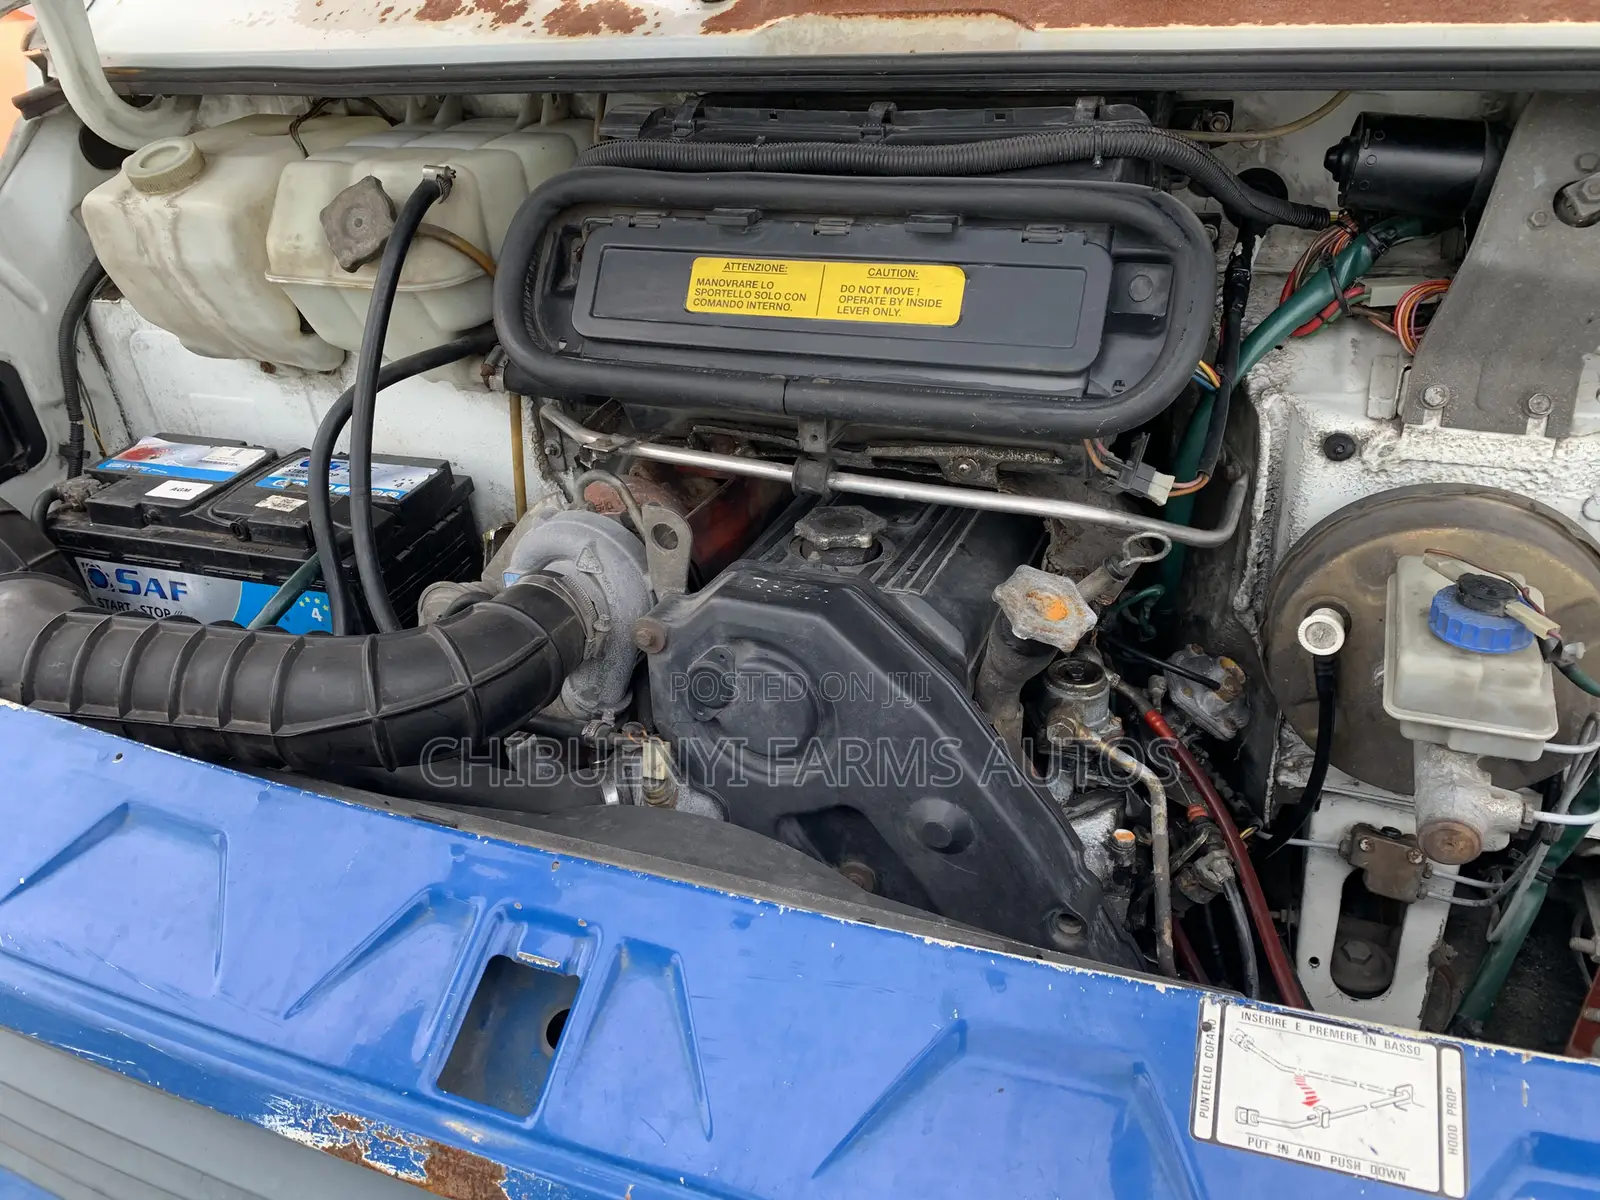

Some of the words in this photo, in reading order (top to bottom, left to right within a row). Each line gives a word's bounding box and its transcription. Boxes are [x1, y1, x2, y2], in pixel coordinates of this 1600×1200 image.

[724, 262, 788, 273] ATTENZIONE:
[868, 268, 918, 278] CAUTION:
[696, 279, 758, 289] MANOVRARE
[761, 280, 773, 289] LO
[840, 285, 855, 293] DO
[858, 285, 881, 294] NOT
[883, 286, 914, 295] MOVE
[695, 288, 752, 300] SPORTELLO
[754, 291, 782, 300] SOLO
[784, 292, 806, 301] CON
[693, 299, 744, 309] COMANDO
[746, 301, 793, 311] INTERNO.
[839, 295, 887, 305] OPERATE
[889, 297, 904, 305] BY
[906, 298, 942, 308] INSIDE
[837, 306, 870, 316] LEVER
[873, 307, 902, 317] ONLY.
[311, 608, 322, 621] 4
[1241, 1012, 1287, 1028] INSERIRE
[1296, 1021, 1301, 1031] E
[1309, 1025, 1359, 1043] PREMERE
[1365, 1035, 1376, 1046] IN
[1384, 1038, 1421, 1056] BASSO
[1199, 1064, 1212, 1118] PUNTELLO
[1447, 1087, 1457, 1116] PROP
[1447, 1123, 1458, 1156] HOOD
[1248, 1137, 1270, 1152] PUT
[1278, 1142, 1289, 1154] IN
[1298, 1147, 1321, 1162] AND
[1331, 1155, 1361, 1171] PUSH
[1371, 1165, 1406, 1182] DOWN
